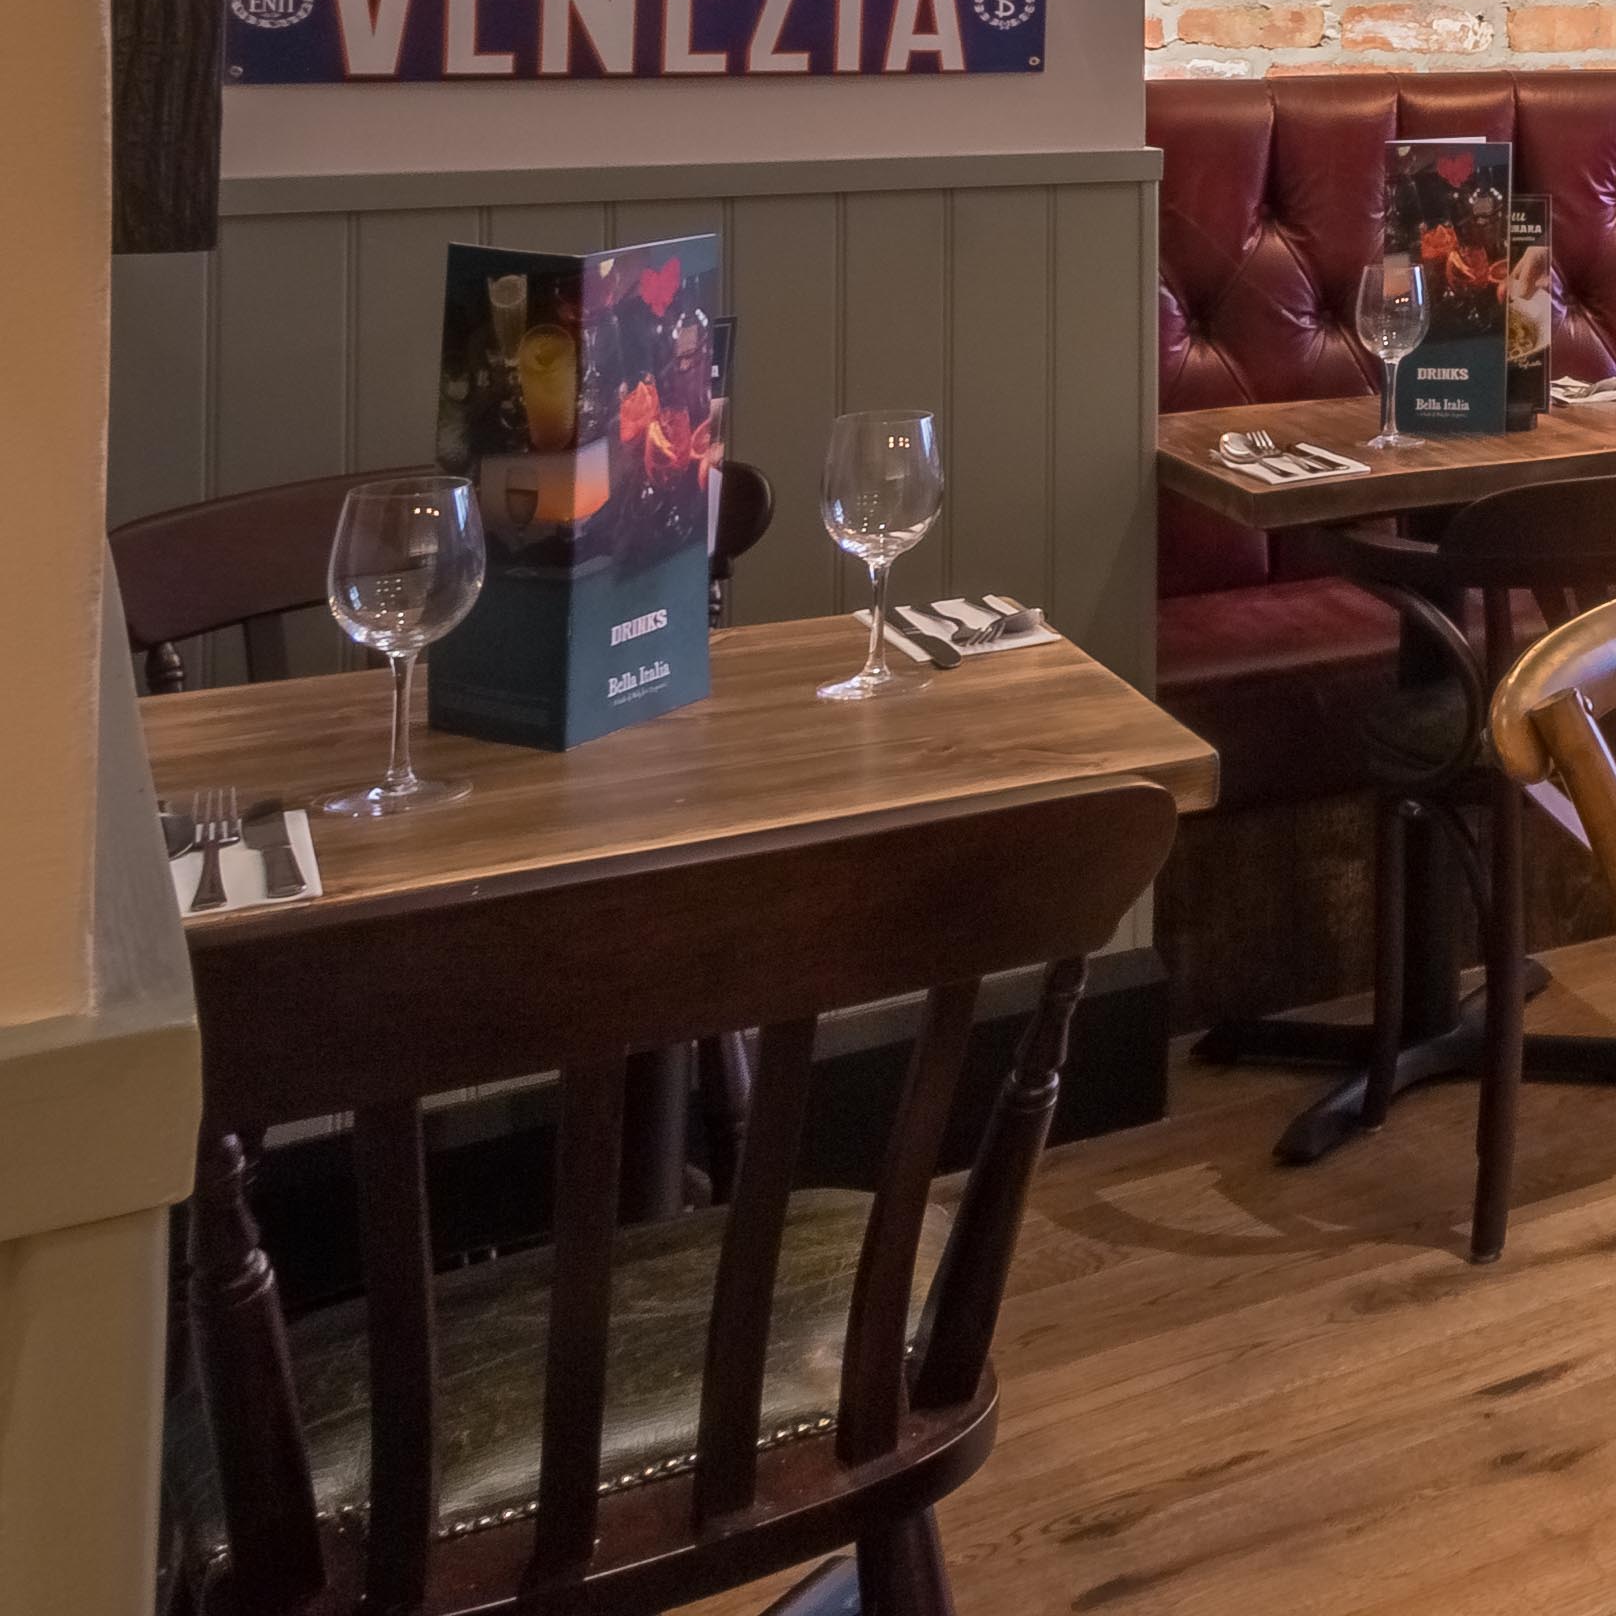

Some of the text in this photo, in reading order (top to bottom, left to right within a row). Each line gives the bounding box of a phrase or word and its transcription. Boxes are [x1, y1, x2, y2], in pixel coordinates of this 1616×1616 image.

[1416, 367, 1470, 380] DRINKS
[1415, 397, 1470, 411] Bella Italia
[610, 609, 668, 646] DRINKS
[607, 671, 638, 698] Bella
[639, 660, 671, 686] Italia
